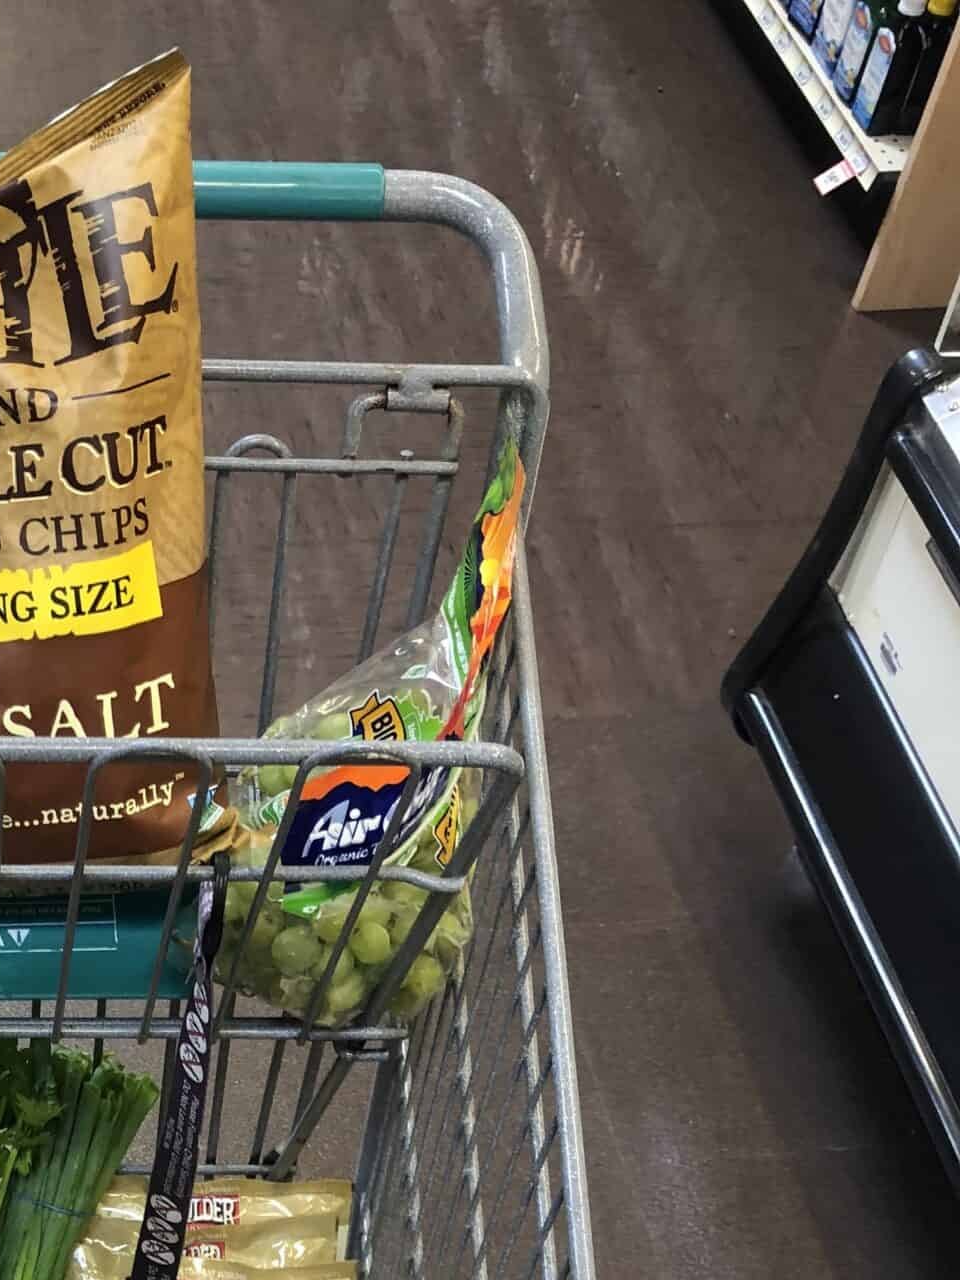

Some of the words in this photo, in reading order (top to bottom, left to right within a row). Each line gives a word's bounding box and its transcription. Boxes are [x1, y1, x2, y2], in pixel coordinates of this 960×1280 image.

[19, 497, 150, 556] CHIPS
[50, 575, 135, 618] SIZE
[2, 672, 175, 738] SALT
